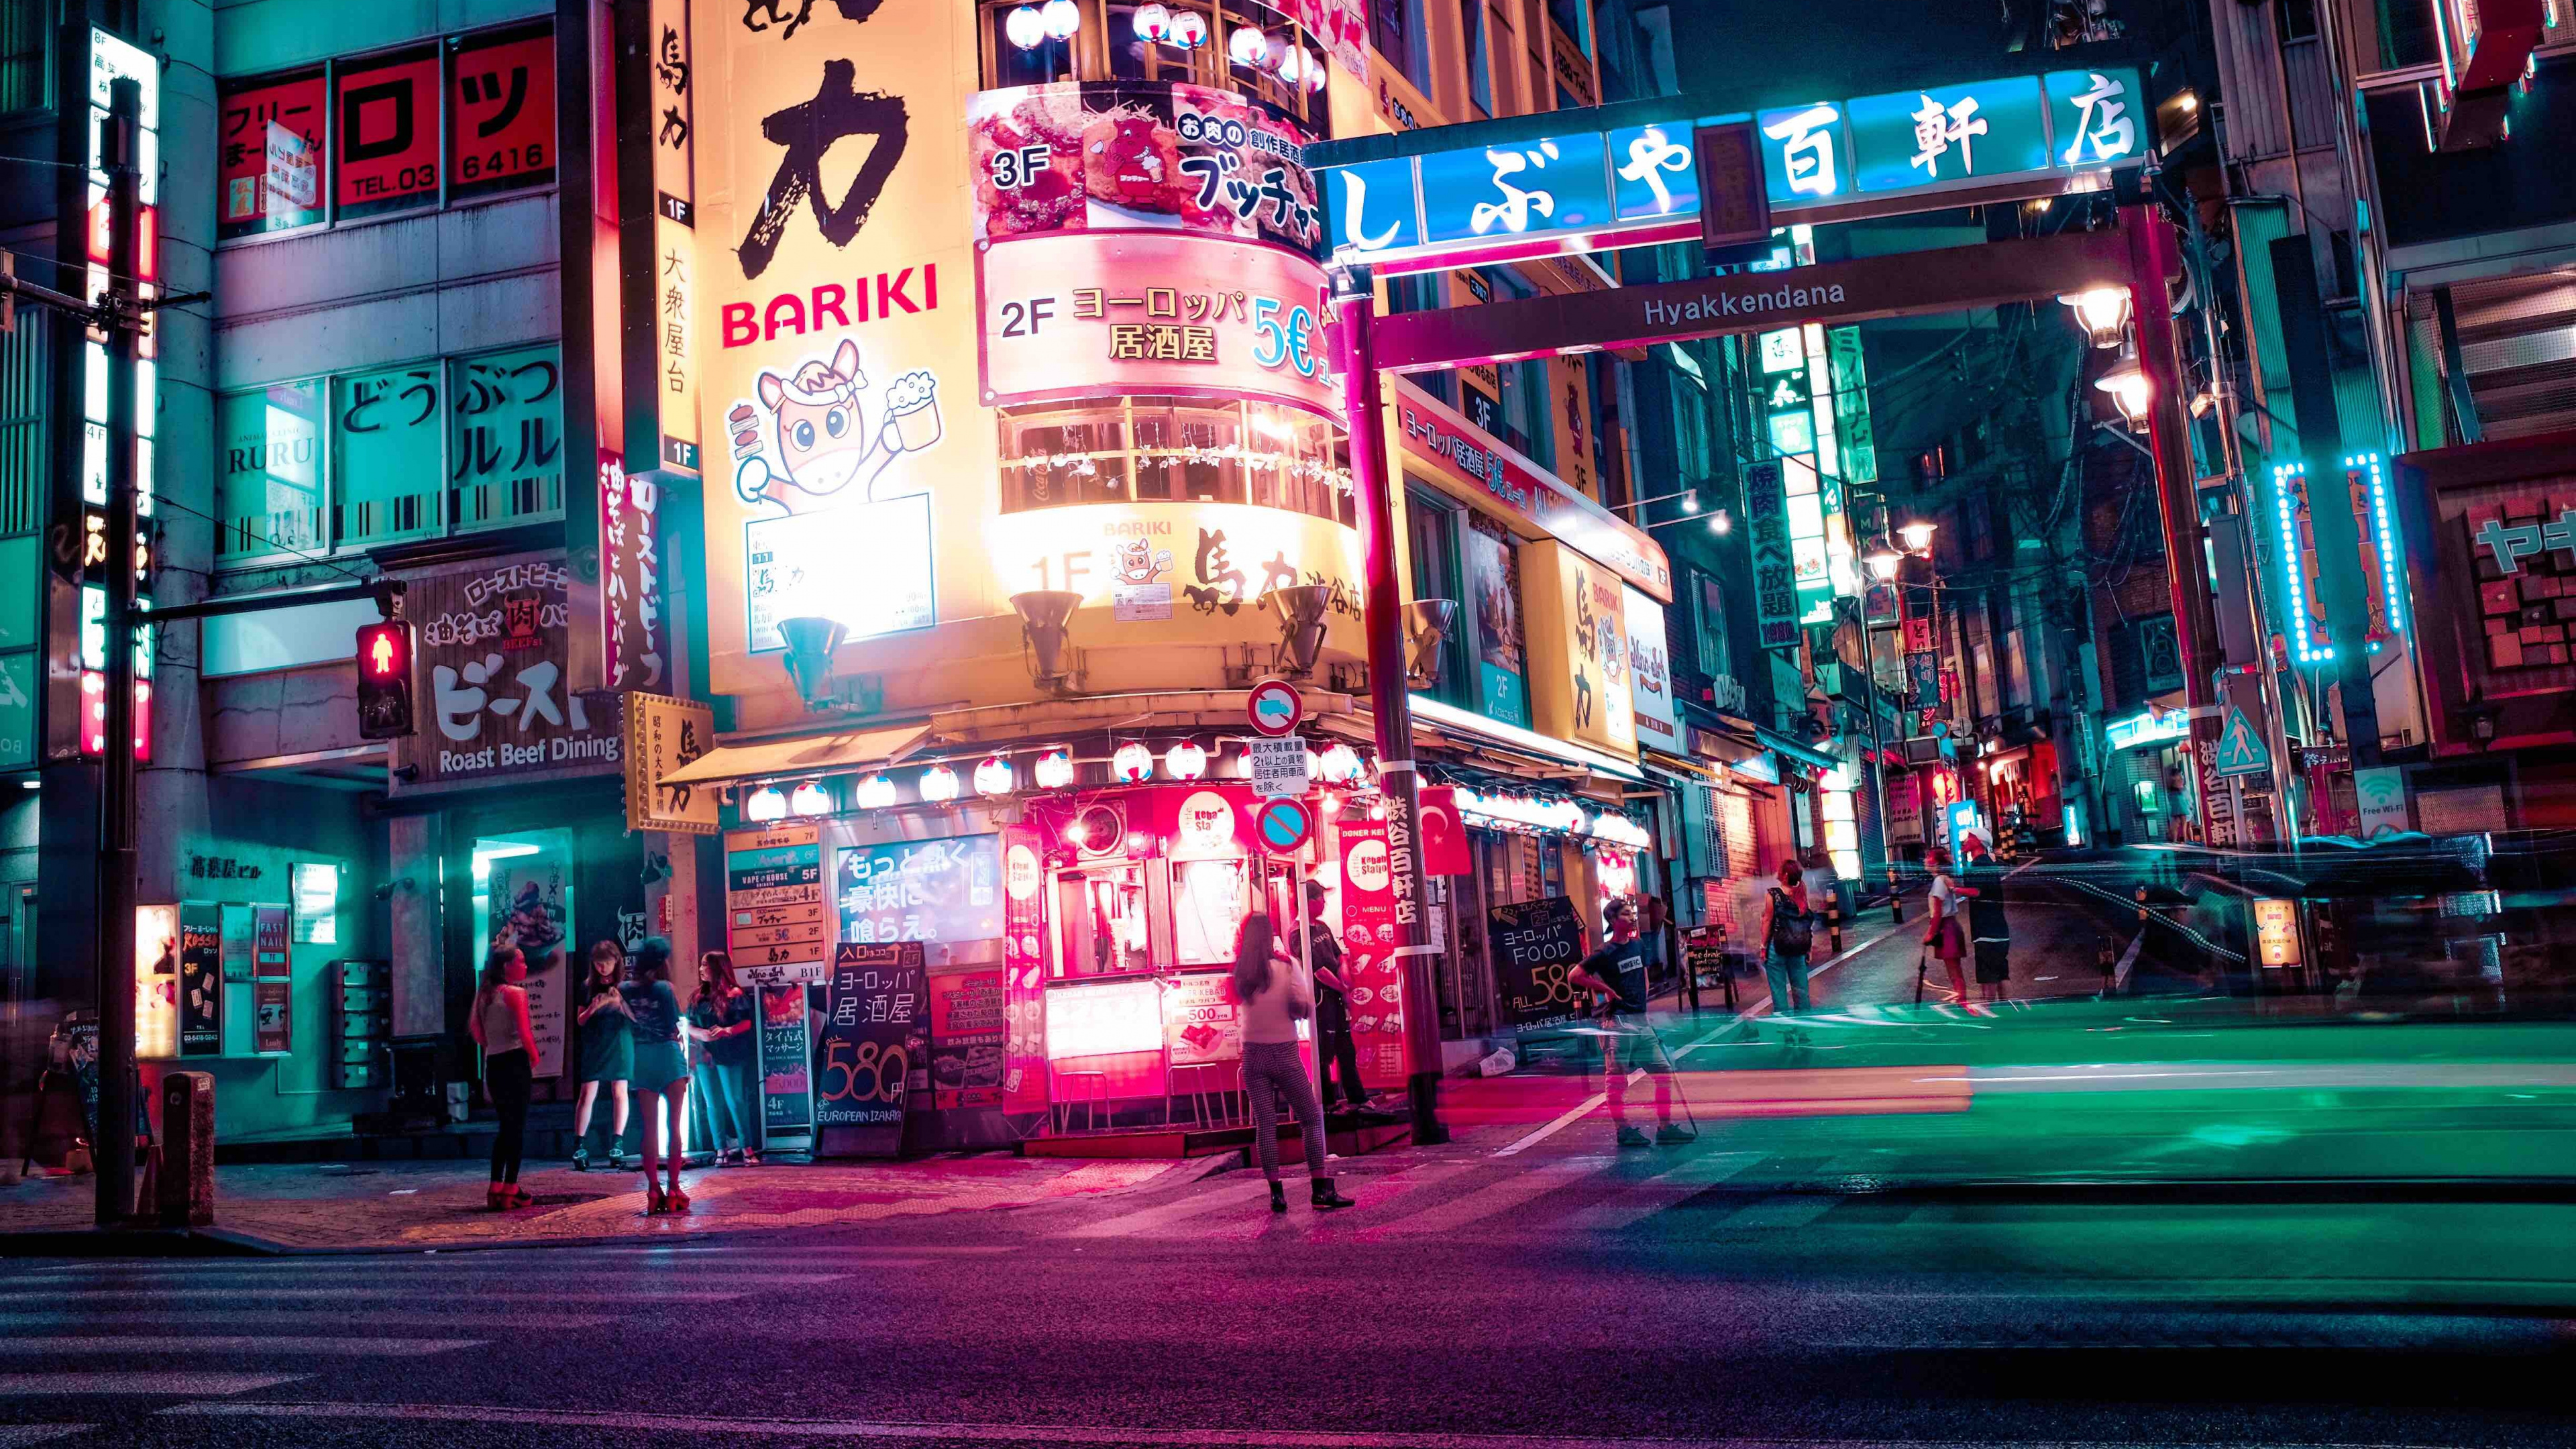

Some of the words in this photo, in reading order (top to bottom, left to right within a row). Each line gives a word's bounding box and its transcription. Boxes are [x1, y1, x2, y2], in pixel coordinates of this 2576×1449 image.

[656, 22, 689, 150] 馬力
[227, 101, 312, 137] フリー
[1178, 113, 1246, 148] お肉の
[462, 143, 544, 178] 6416
[992, 144, 1051, 191] 3F
[667, 198, 686, 220] 1F
[721, 262, 938, 350] BARIKI
[1073, 286, 1247, 322] ヨーロッパ
[1644, 282, 1845, 327] Hyakkendana
[664, 247, 686, 394] 大衆屋台
[1002, 297, 1055, 338] 2F
[1108, 323, 1217, 362] 居酒屋
[343, 360, 558, 433] どうぶつ
[1474, 397, 1491, 432] 3F
[228, 437, 314, 475] RURU
[454, 417, 561, 481] ルル
[674, 441, 692, 466] 1F
[1405, 409, 1485, 480] ヨーロッパ居酒屋
[1104, 521, 1173, 536] BARIKI
[1747, 466, 1794, 619] 焼肉食べ放題
[629, 478, 663, 688] ローストビーフ
[424, 609, 504, 647] 油そば
[1574, 566, 1596, 731] 馬力
[1496, 674, 1508, 699] 2F
[440, 744, 496, 774] Roast
[500, 739, 546, 767] Beef
[551, 733, 619, 763] Dining
[1252, 741, 1303, 753] 最大積載量
[1252, 754, 1304, 767] 2t以上の貨物
[1254, 767, 1305, 780] 居住者用車両
[1255, 781, 1283, 792] を除く
[2363, 806, 2381, 816] Free
[2382, 804, 2404, 814] Wi-Fi
[1342, 829, 1369, 838] DONER
[848, 843, 969, 879] もっと熱く
[1361, 864, 1387, 875] Statio
[1385, 796, 1417, 925] 渋谷百軒店
[742, 875, 759, 885] VAPE
[766, 873, 788, 881] HOUSE
[802, 867, 818, 880] 5F
[799, 885, 820, 901] 4F
[848, 882, 924, 914] 豪快に
[808, 908, 818, 917] 3F
[1362, 906, 1387, 914] MENU
[260, 922, 284, 933] FAST
[808, 926, 819, 935] 2F
[1503, 924, 1562, 946] ヨーロッパ
[260, 936, 284, 947] NAIL
[809, 947, 820, 956] 1F
[1513, 941, 1571, 965] FOOD
[184, 962, 199, 974] 3F
[800, 967, 822, 977] B1F
[839, 969, 916, 990] ヨーロッパ
[833, 993, 915, 1026] 居酒屋
[1188, 1008, 1216, 1020] 500
[1513, 996, 1533, 1009] ALL
[765, 1030, 804, 1042] タイ古式
[765, 1042, 804, 1053] マッサージ
[767, 1095, 785, 1110] 4F
[817, 1110, 869, 1122] EUROPEAN
[869, 1110, 902, 1122] IZAKAYA
